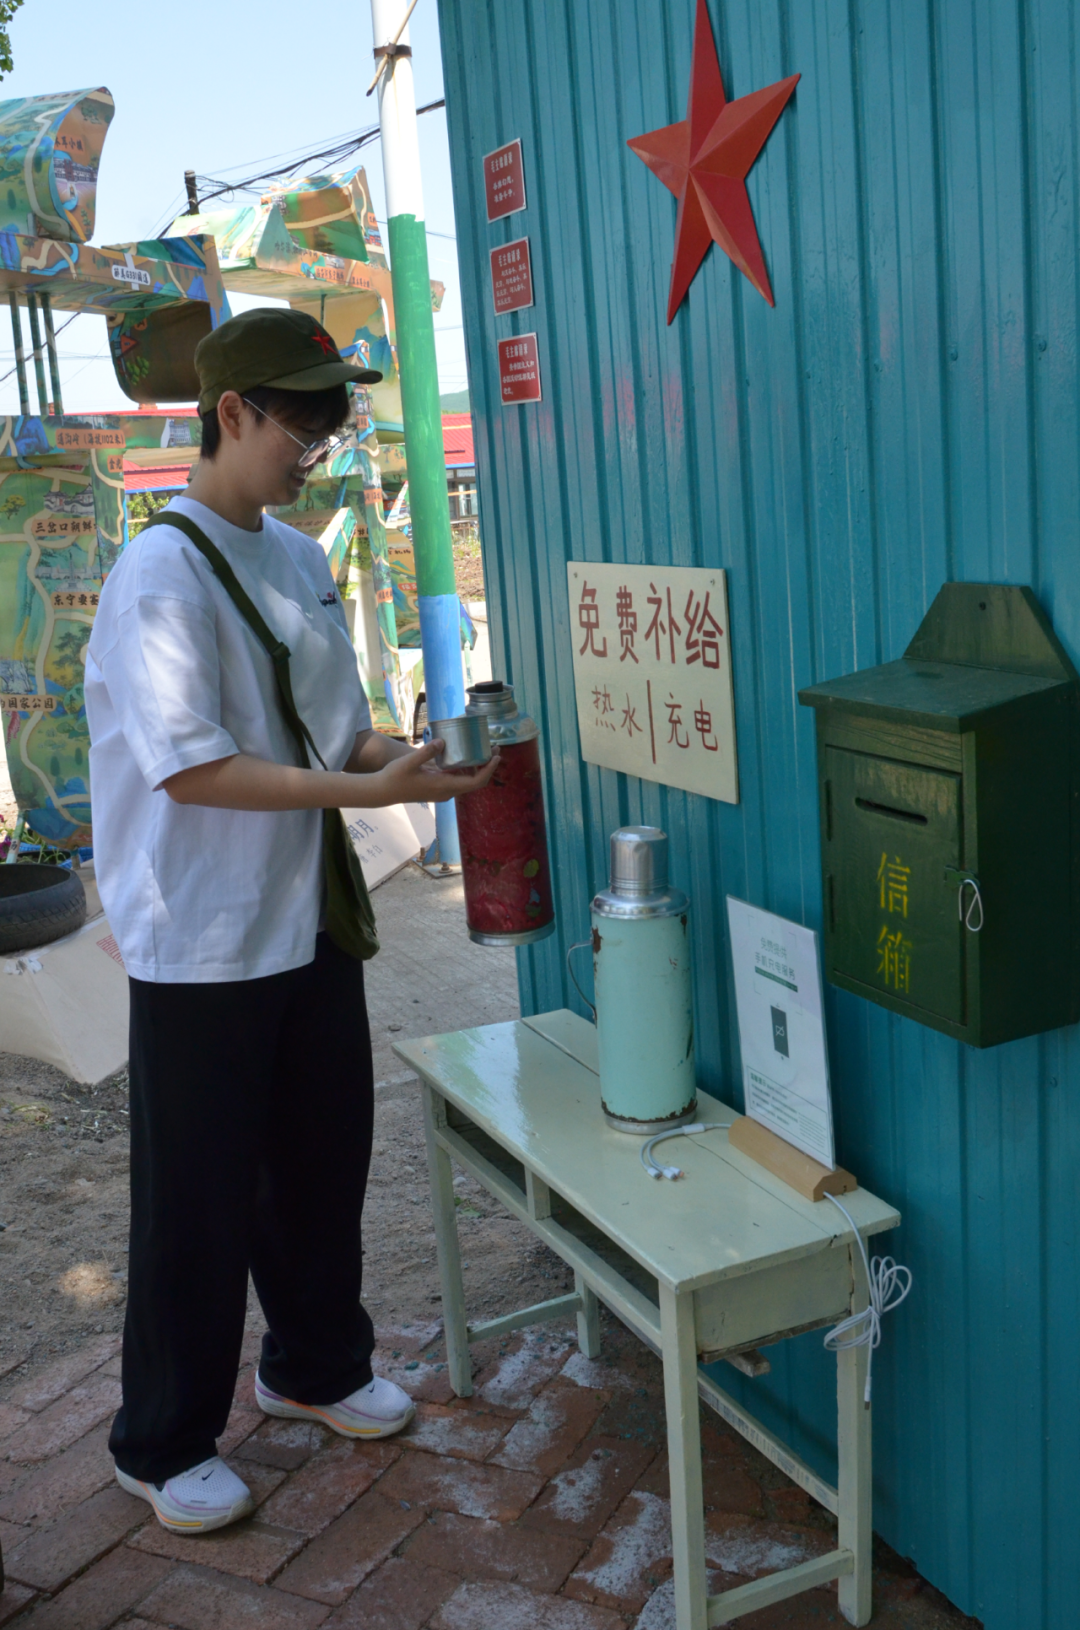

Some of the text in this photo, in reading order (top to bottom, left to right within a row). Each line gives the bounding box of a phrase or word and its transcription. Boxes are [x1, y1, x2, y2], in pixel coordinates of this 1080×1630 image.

[35, 519, 98, 534] 三岔口朝鲜
[53, 593, 99, 606] 东宁要塞
[578, 580, 724, 669] 免费补给
[591, 684, 719, 752] 热水 充电
[876, 852, 912, 994] 信箱
